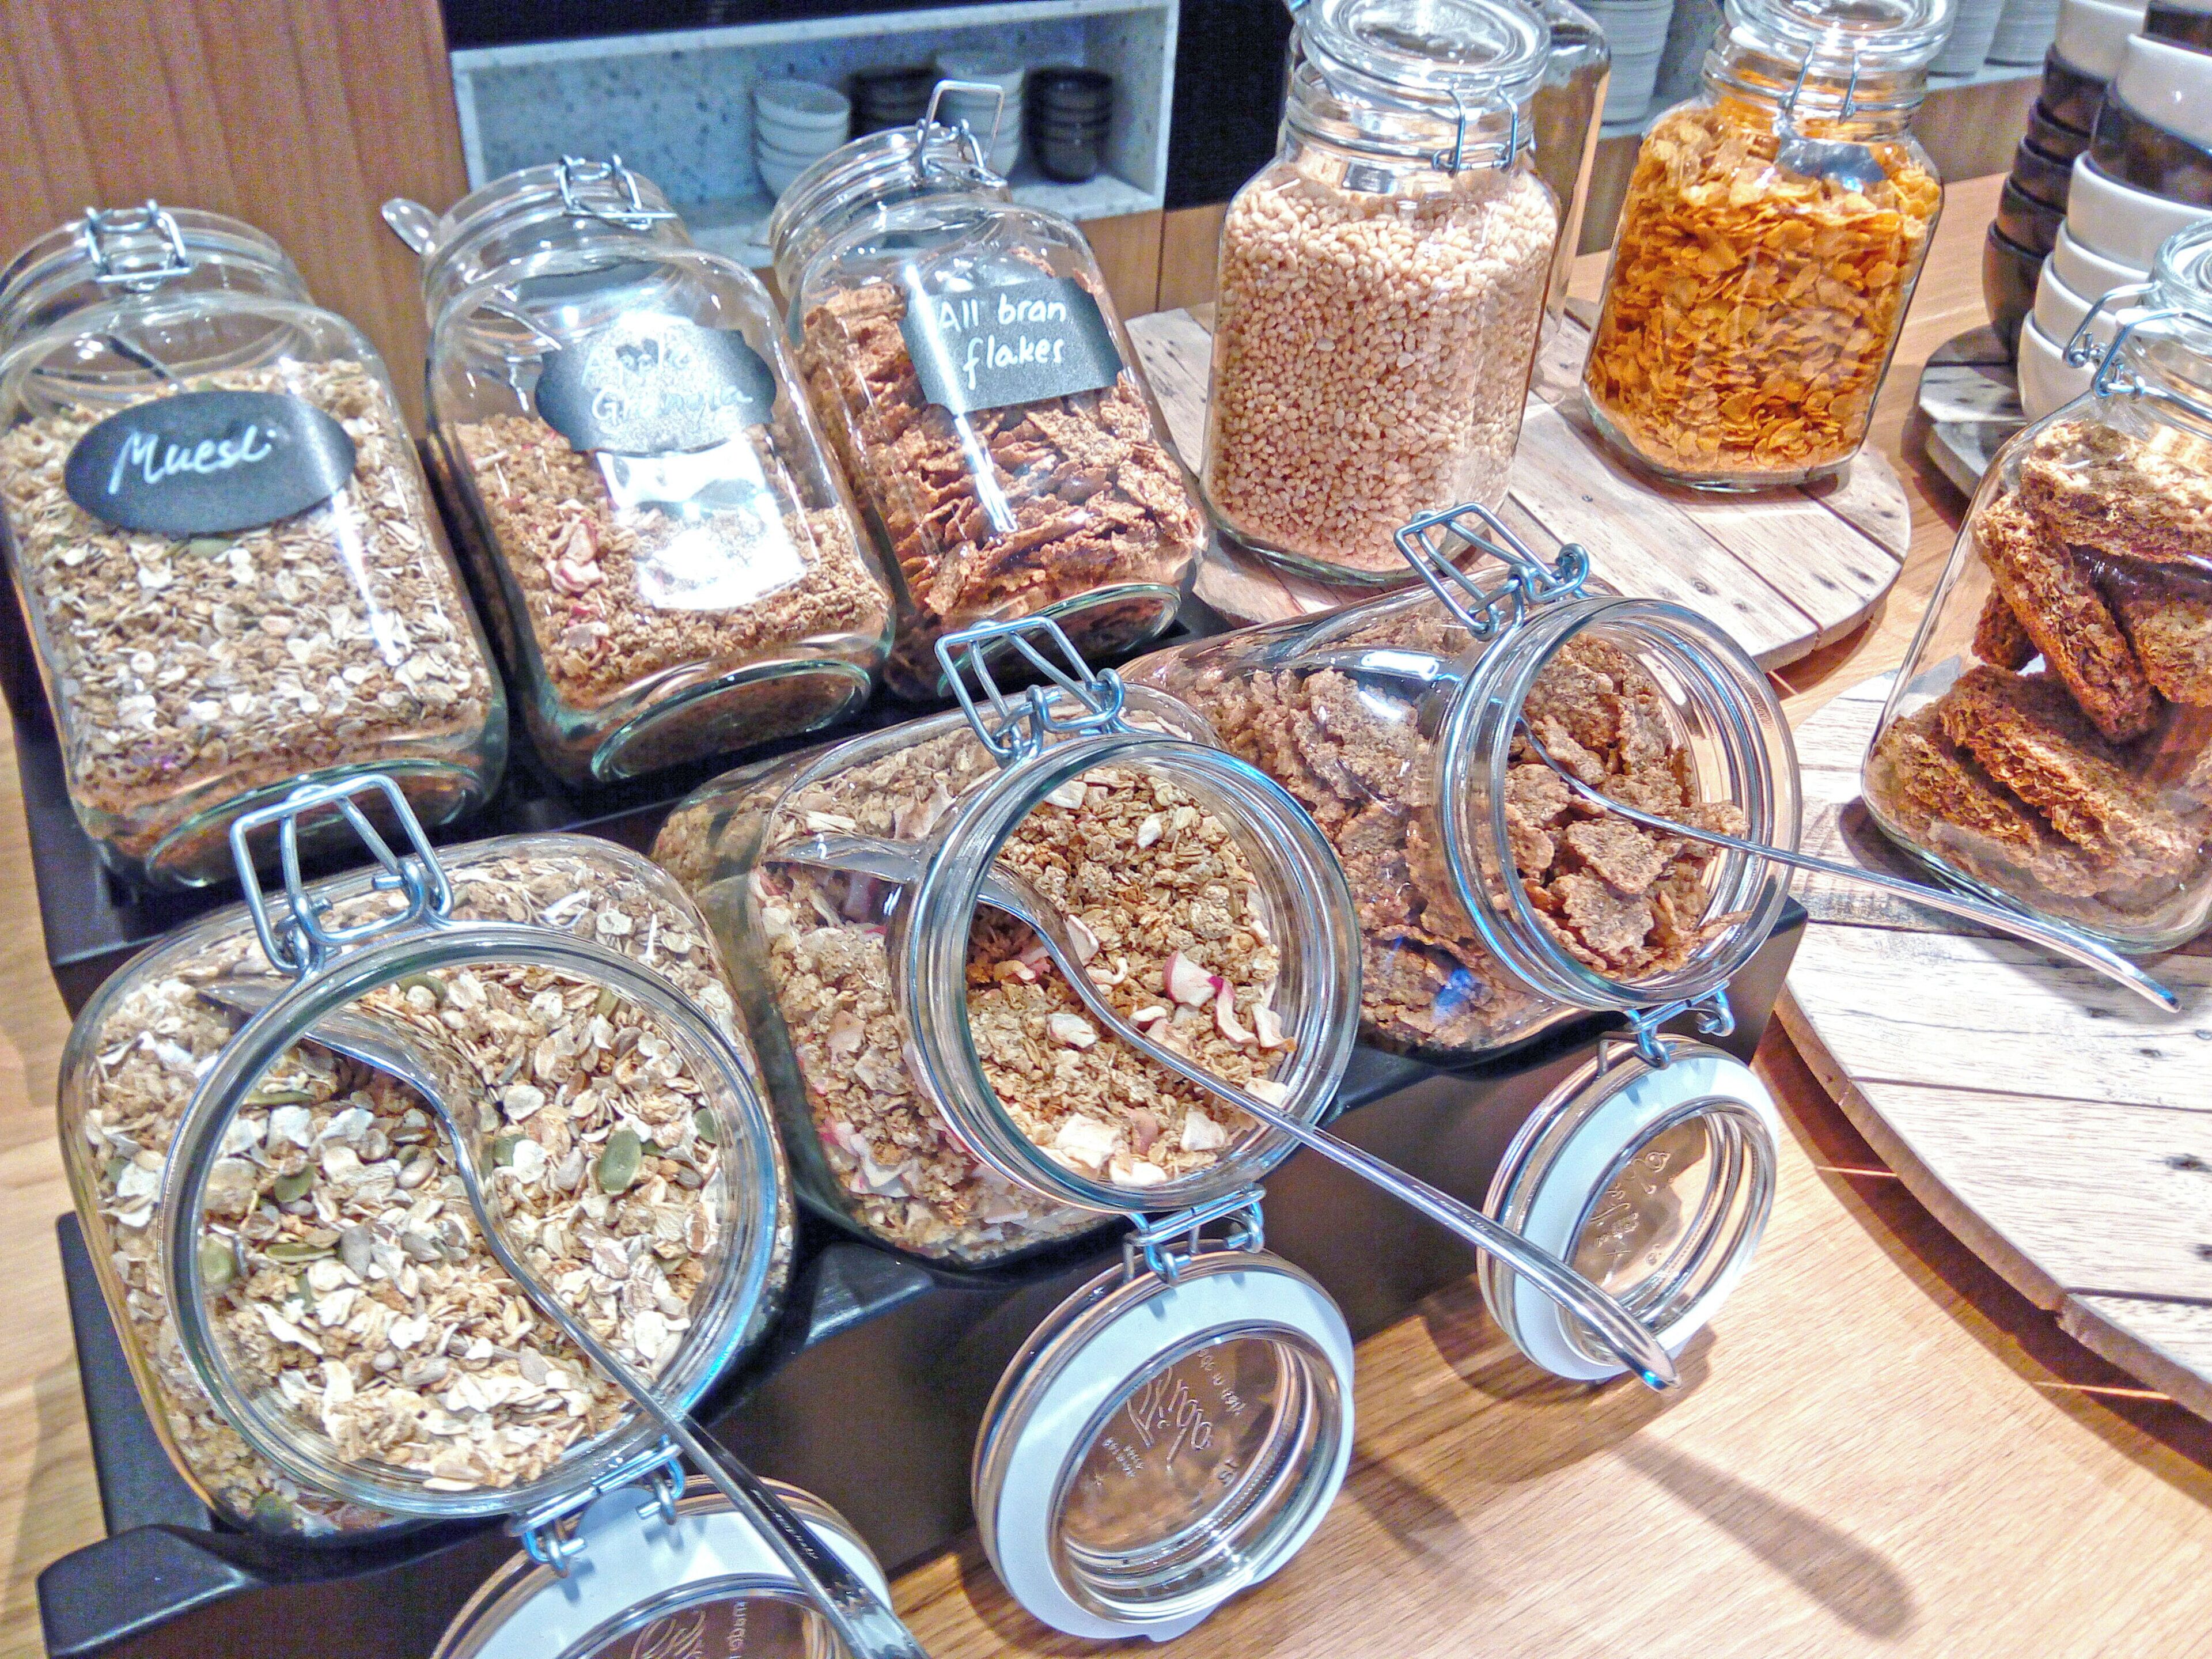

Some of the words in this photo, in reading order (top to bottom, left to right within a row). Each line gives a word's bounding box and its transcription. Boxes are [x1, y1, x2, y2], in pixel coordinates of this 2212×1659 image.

[940, 299, 979, 333] All
[998, 293, 1067, 325] bran
[963, 334, 1064, 391] flakes
[108, 425, 277, 494] Muesli
